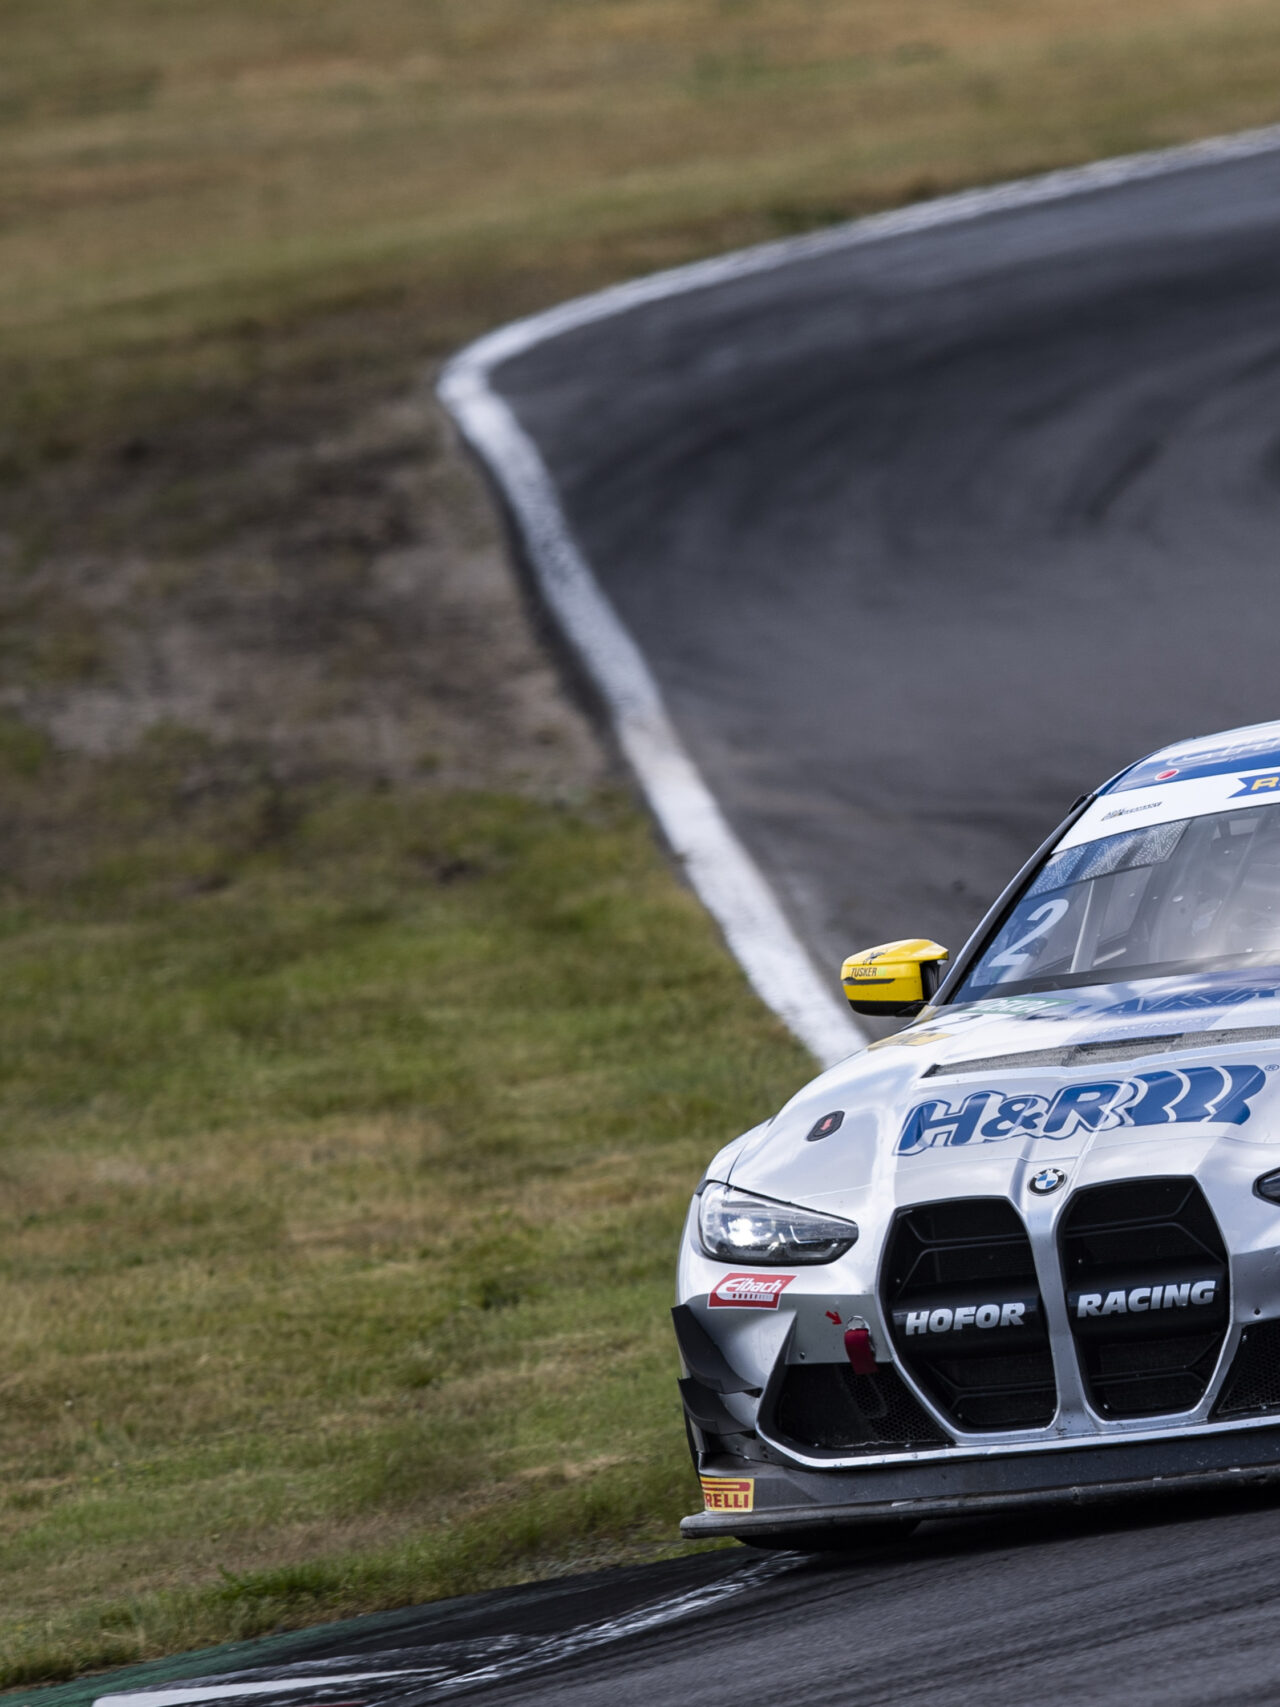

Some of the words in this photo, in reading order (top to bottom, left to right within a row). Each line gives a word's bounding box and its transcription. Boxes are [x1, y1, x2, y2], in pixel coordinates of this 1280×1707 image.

[988, 899, 1069, 967] 2
[892, 1079, 1145, 1156] H&R
[715, 1277, 784, 1302] Eibach
[906, 1303, 1025, 1336] HOFOR
[1077, 1280, 1216, 1318] RACING
